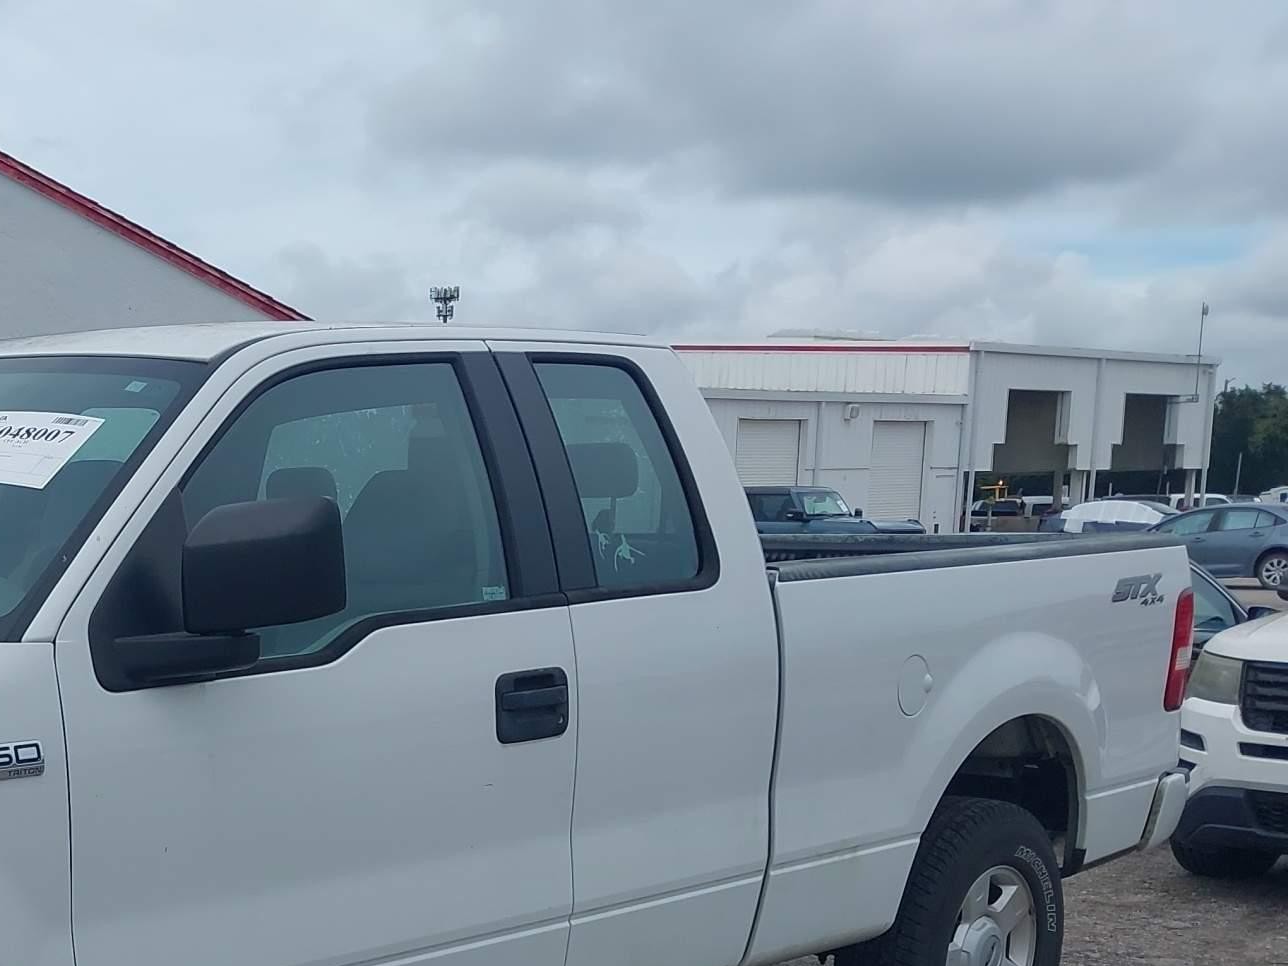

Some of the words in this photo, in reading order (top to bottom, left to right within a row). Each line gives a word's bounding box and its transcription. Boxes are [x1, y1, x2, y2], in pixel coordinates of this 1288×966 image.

[1112, 573, 1162, 602] STX
[7, 766, 42, 777] TRITON
[1014, 845, 1057, 932] MICHELIN
